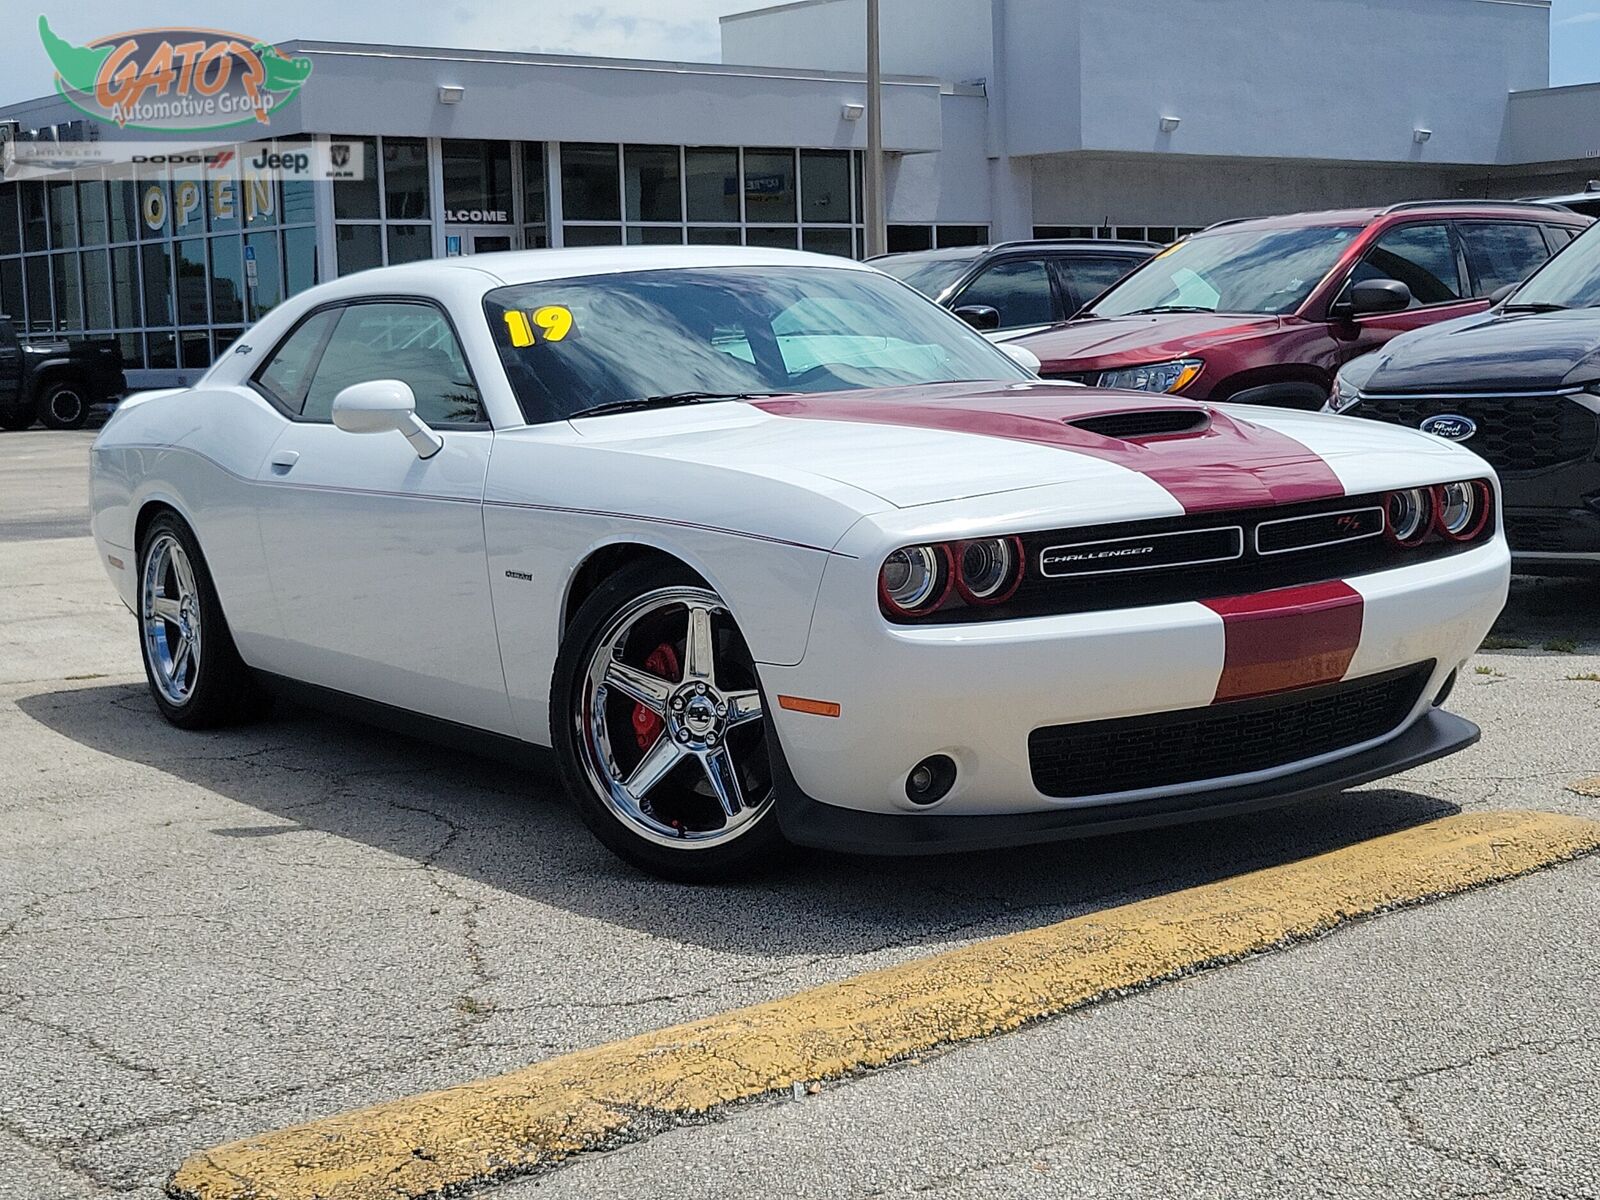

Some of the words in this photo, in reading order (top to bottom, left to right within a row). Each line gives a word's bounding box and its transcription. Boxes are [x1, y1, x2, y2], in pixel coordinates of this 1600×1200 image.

[143, 172, 275, 231] OPEN
[503, 305, 572, 347] 19
[1432, 420, 1461, 436] Ford
[1043, 546, 1153, 564] CHALLENGER
